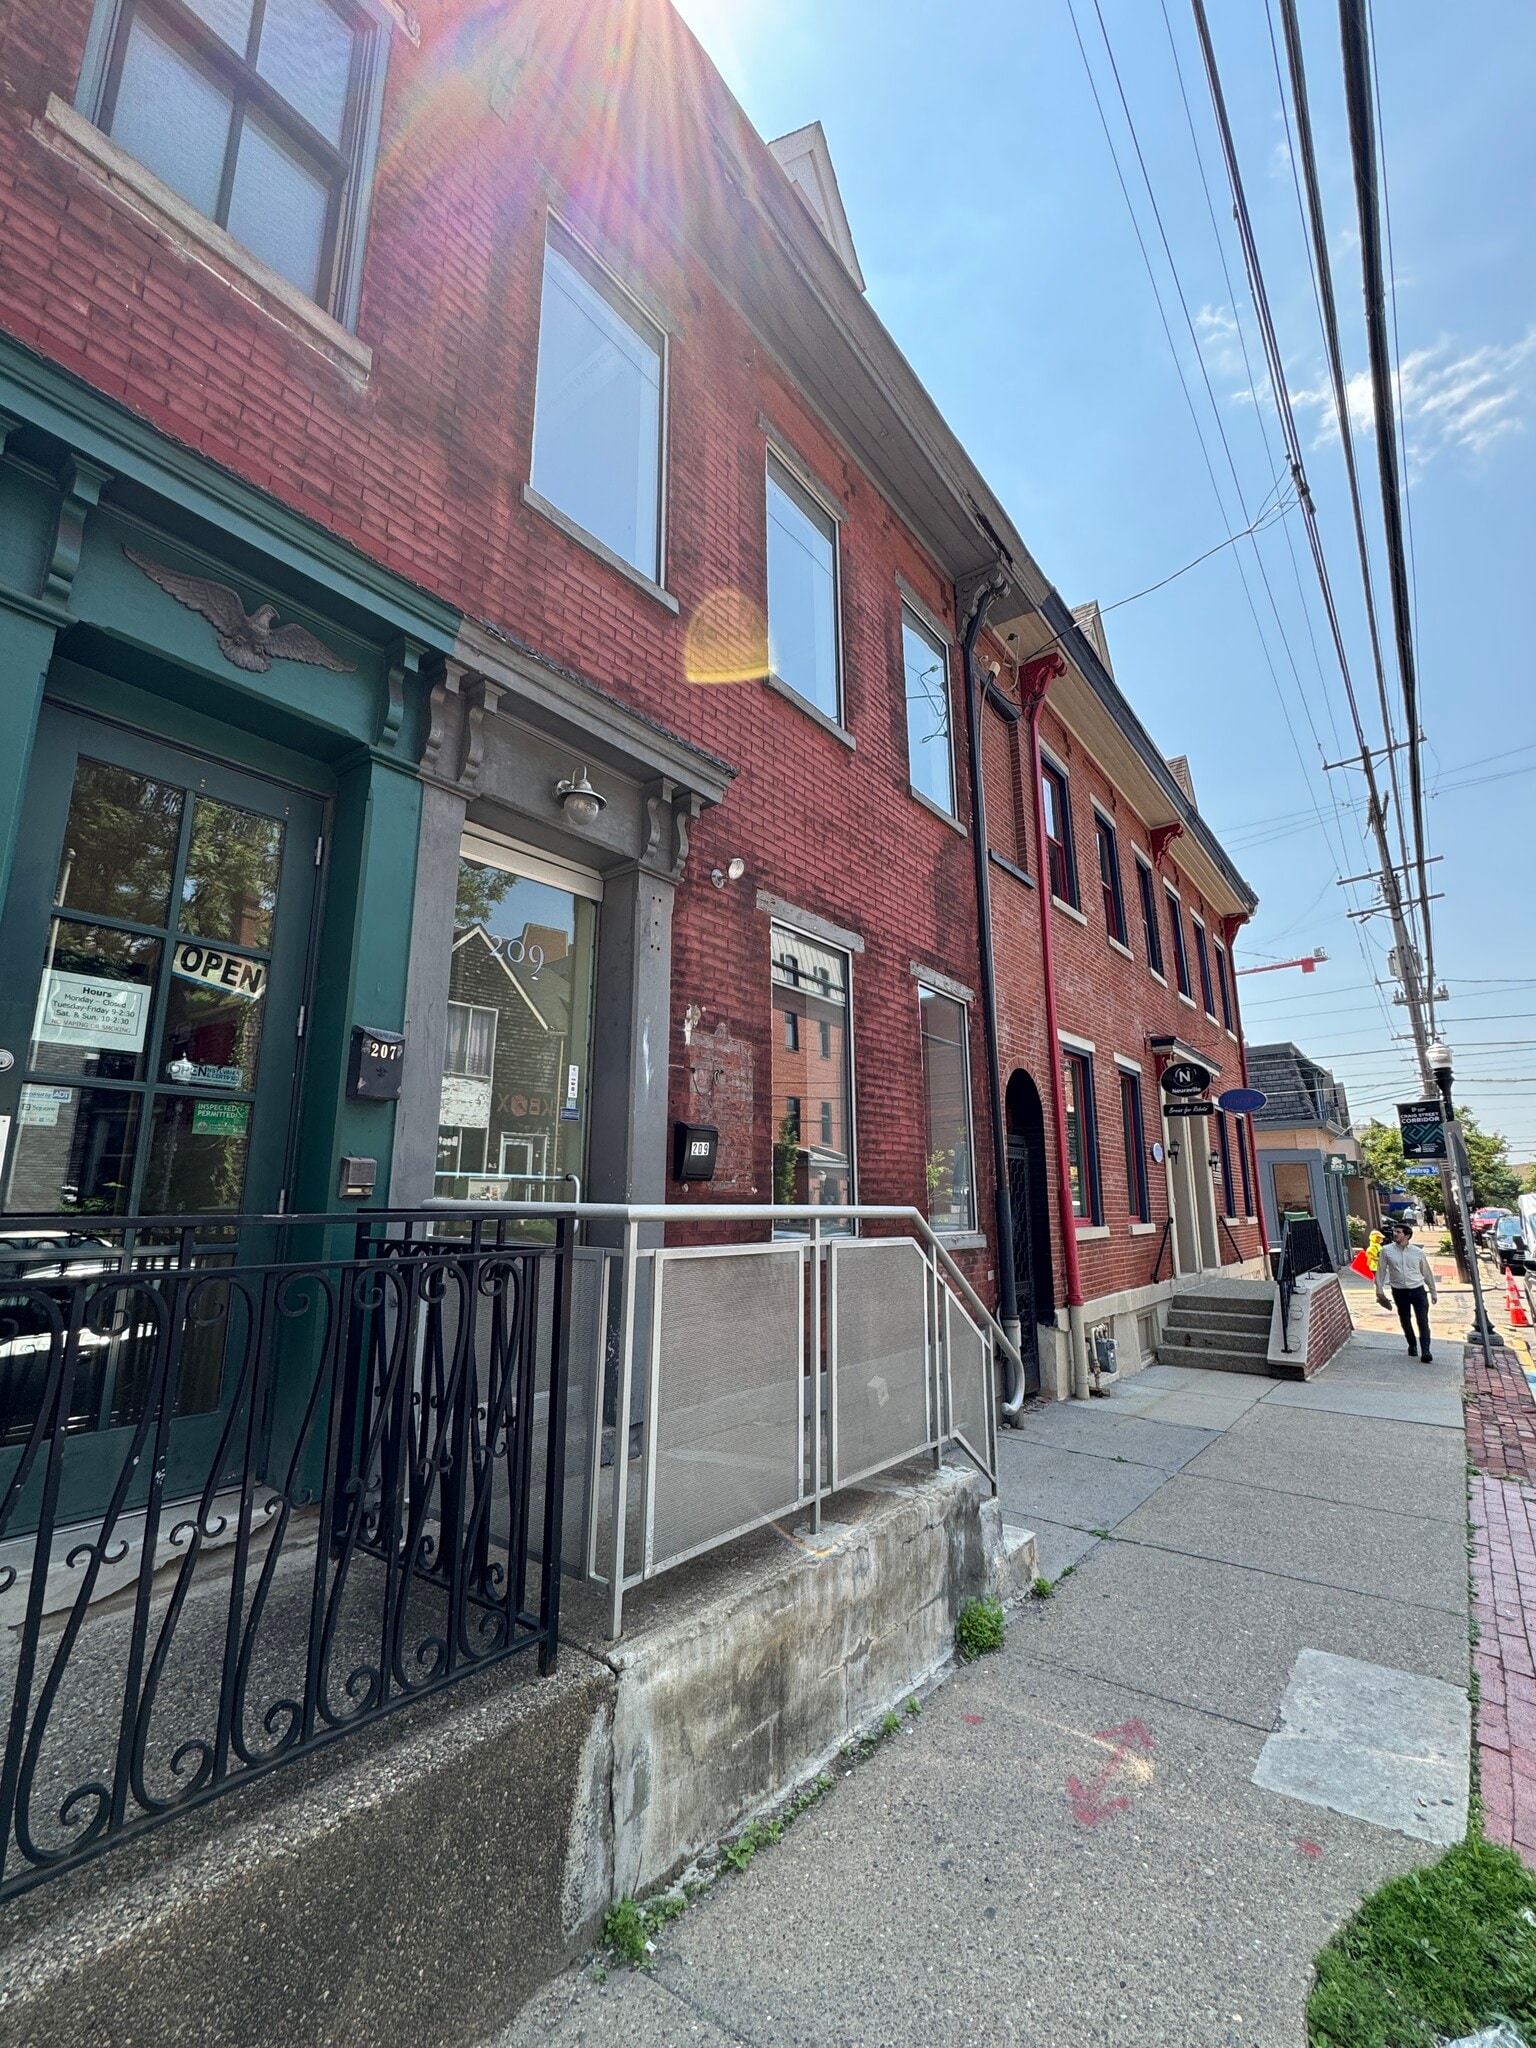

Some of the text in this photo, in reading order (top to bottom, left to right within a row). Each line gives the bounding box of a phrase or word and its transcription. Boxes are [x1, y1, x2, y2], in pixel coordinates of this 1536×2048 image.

[490, 935, 544, 975] 209
[181, 945, 262, 993] OPEN
[82, 986, 112, 998] Hours
[64, 994, 94, 1004] Monday
[102, 999, 127, 1009] Closed
[52, 1000, 135, 1018] Tuesday-Friday 9-2:30
[56, 1010, 71, 1018] Sat.
[81, 1013, 98, 1021] Sun.
[101, 1016, 129, 1025] 10-2:30
[63, 1020, 89, 1028] VAPING
[101, 1024, 131, 1033] SMOKING
[370, 1043, 397, 1060] 207
[169, 1063, 207, 1077] OPEN
[1178, 1070, 1191, 1083] N
[54, 1090, 69, 1099] ADT
[198, 1103, 237, 1111] INSPECTED
[197, 1110, 236, 1118] PERMITTED
[1401, 1116, 1440, 1124] CORRIDOR
[692, 1143, 709, 1155] 209
